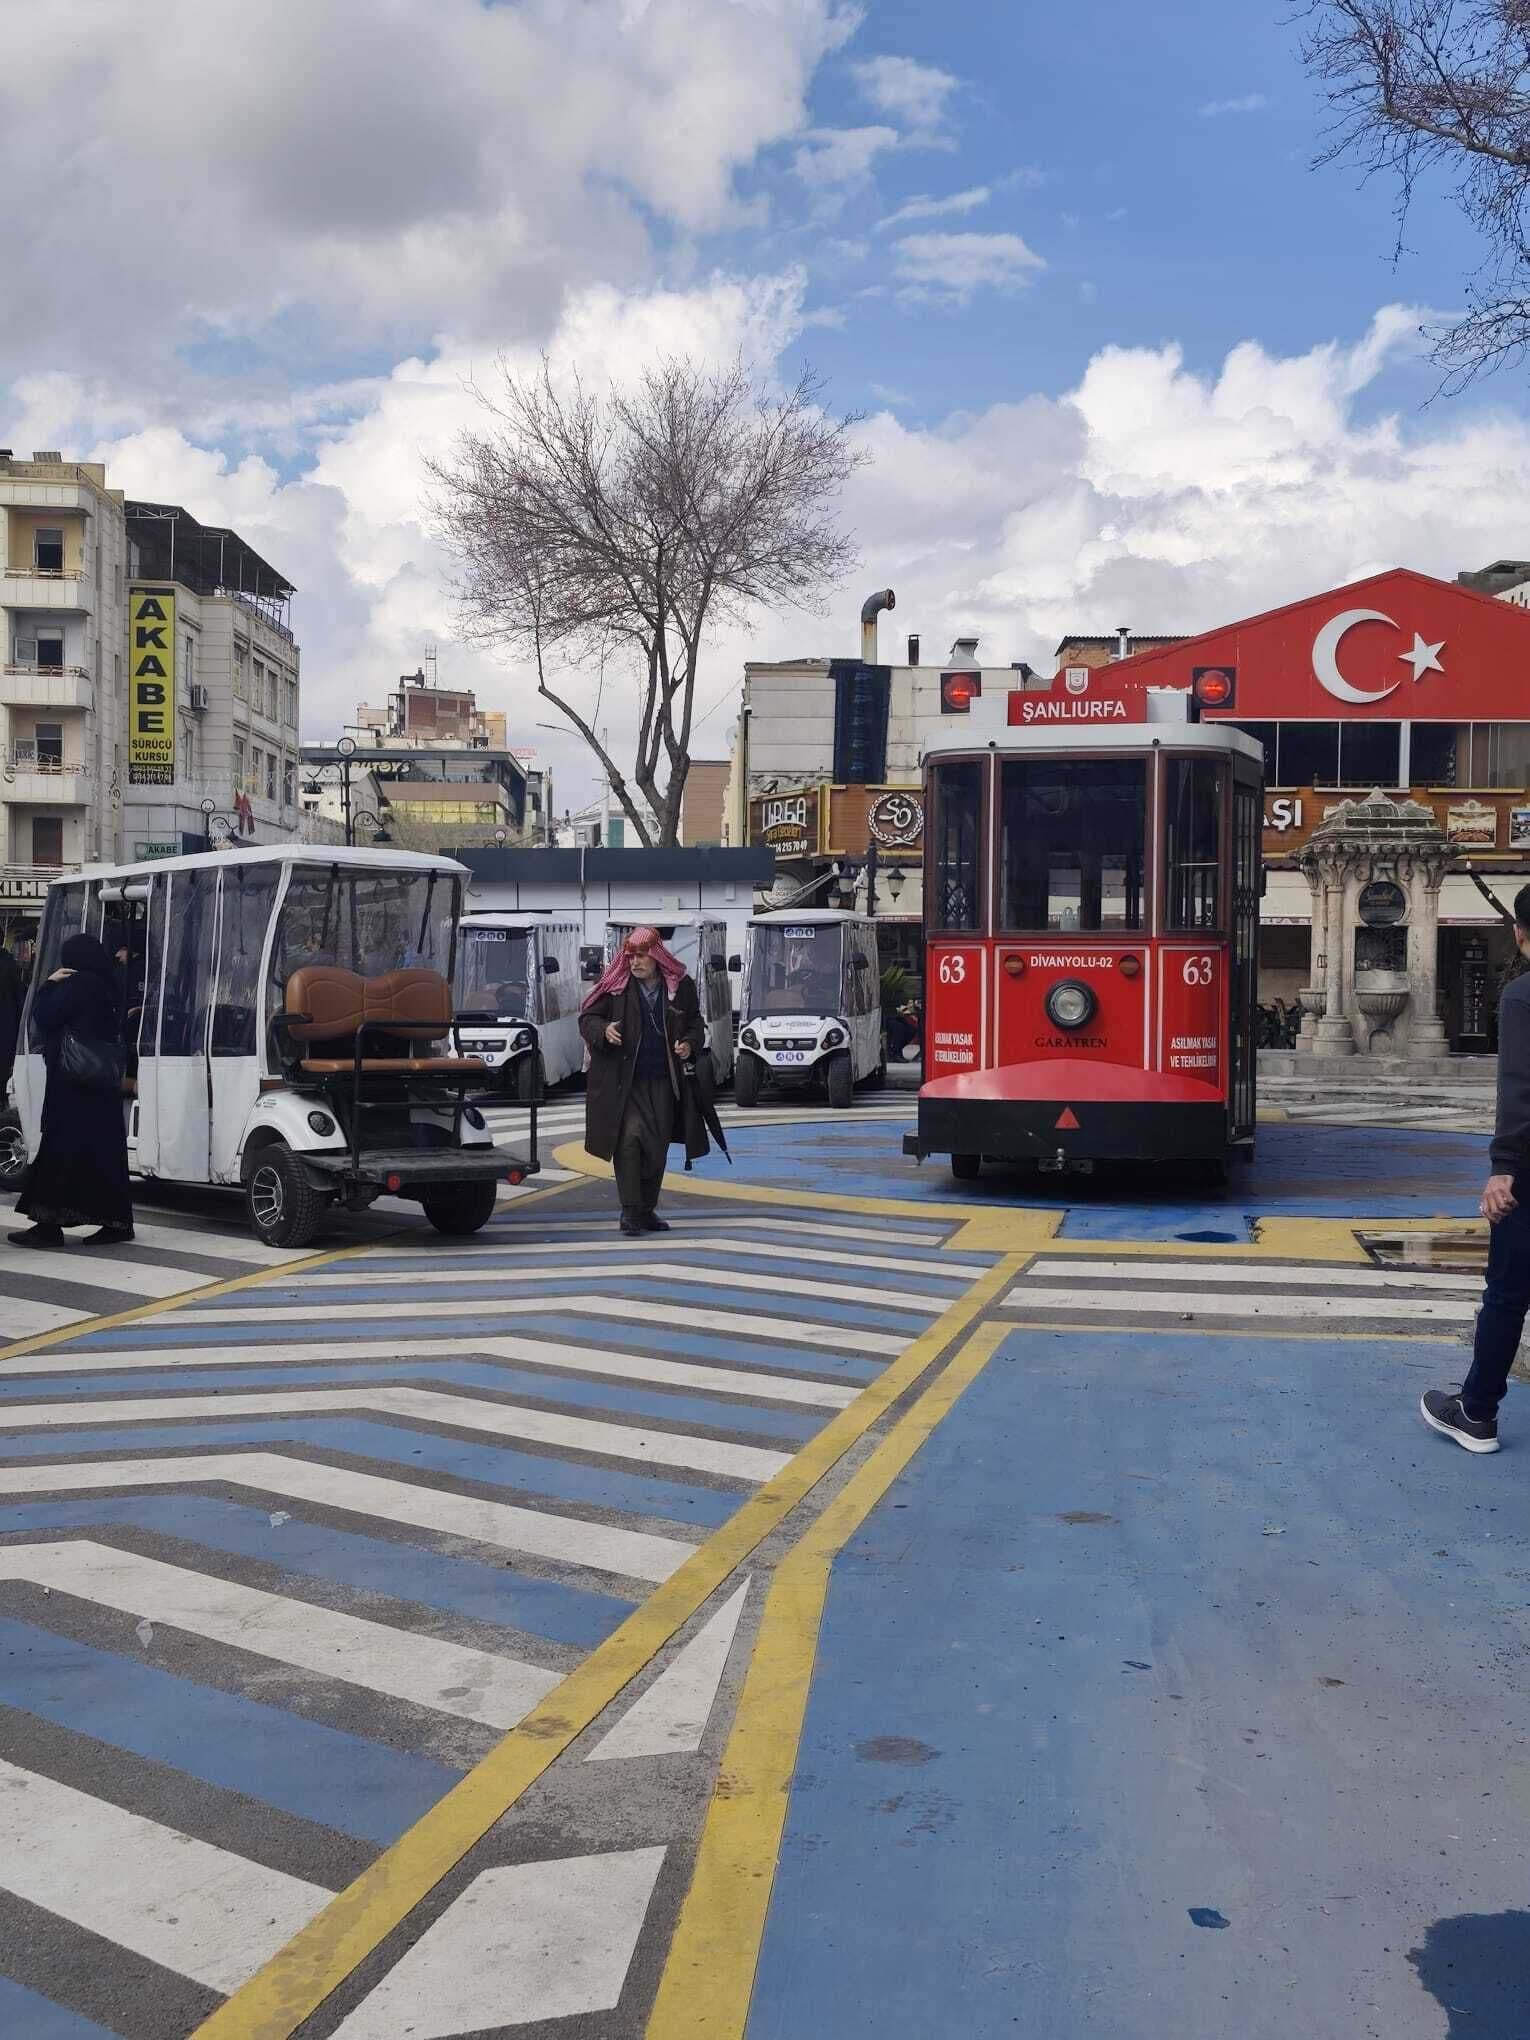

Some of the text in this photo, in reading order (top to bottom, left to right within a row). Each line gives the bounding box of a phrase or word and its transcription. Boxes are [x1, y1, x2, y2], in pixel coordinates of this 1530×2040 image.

[135, 598, 168, 733] AKABE
[1022, 700, 1127, 723] ŞANLIURFA
[135, 751, 169, 761] KURSU
[1263, 799, 1302, 831] ŞI
[148, 845, 178, 854] AKABE
[939, 955, 966, 984] 63
[1030, 953, 1113, 968] DİVANYOLU-02
[1183, 956, 1212, 985] 63
[1170, 1055, 1180, 1068] VE
